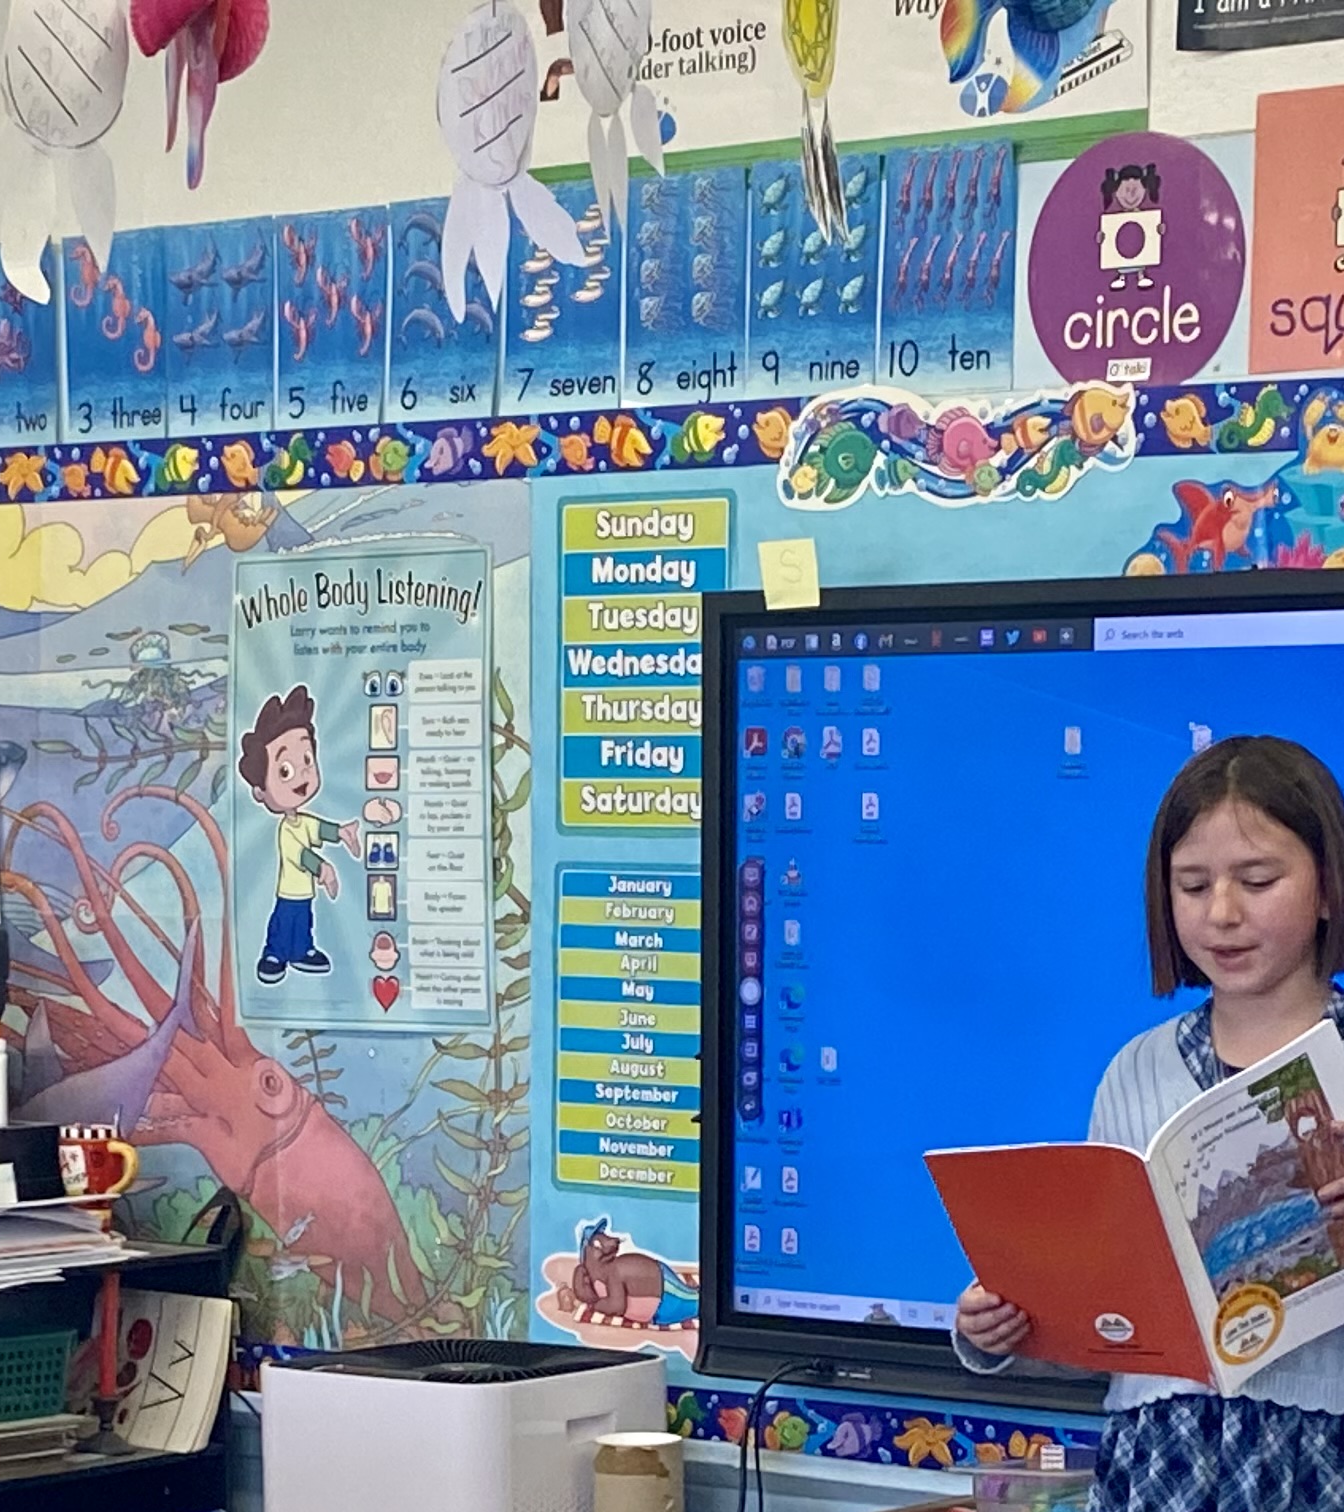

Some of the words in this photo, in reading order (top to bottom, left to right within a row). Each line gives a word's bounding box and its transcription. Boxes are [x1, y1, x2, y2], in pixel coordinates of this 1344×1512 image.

[710, 19, 766, 47] voice
[678, 45, 757, 76] talking)
[1063, 285, 1201, 350] circle
[762, 351, 780, 385] 9
[809, 351, 860, 382] nine
[890, 339, 919, 378] 10
[949, 333, 991, 371] ten
[401, 378, 417, 410] 6
[450, 376, 476, 404] six
[518, 368, 534, 401] 7
[549, 374, 616, 397] seven
[637, 360, 655, 395] 8
[677, 351, 737, 403] eight
[78, 402, 92, 433] 3
[111, 396, 162, 429] three
[179, 394, 196, 426] 4
[220, 387, 265, 422] four
[289, 387, 305, 419] 5
[331, 380, 369, 414] five
[16, 401, 47, 433] two
[596, 508, 694, 541] Sunday
[591, 555, 696, 588] Monday
[778, 550, 804, 583] S
[238, 577, 308, 629] Whole
[314, 567, 369, 616] Body
[376, 567, 483, 625] Listening!
[290, 622, 316, 638] Larry
[319, 623, 348, 636] wants
[349, 622, 360, 635] to
[362, 621, 396, 635] remind
[399, 622, 419, 641] you
[420, 621, 431, 632] to
[587, 601, 698, 634] Tuesday
[293, 642, 319, 656] listen
[322, 641, 342, 655] with
[344, 643, 368, 658] your
[369, 641, 398, 654] entire
[400, 640, 426, 656] body
[567, 647, 702, 677] Wednesda
[581, 693, 702, 727] Thursday
[600, 740, 684, 773] Friday
[580, 784, 702, 820] Saturday
[608, 875, 672, 897] January
[605, 901, 675, 923] February
[615, 931, 663, 948] March
[620, 954, 658, 976] April
[621, 981, 654, 1001] May
[619, 1009, 657, 1026] June
[621, 1033, 654, 1054] July
[609, 1059, 666, 1078] August
[595, 1082, 679, 1105] September
[606, 1112, 668, 1131] October
[599, 1137, 675, 1158] November
[599, 1162, 675, 1184] December
